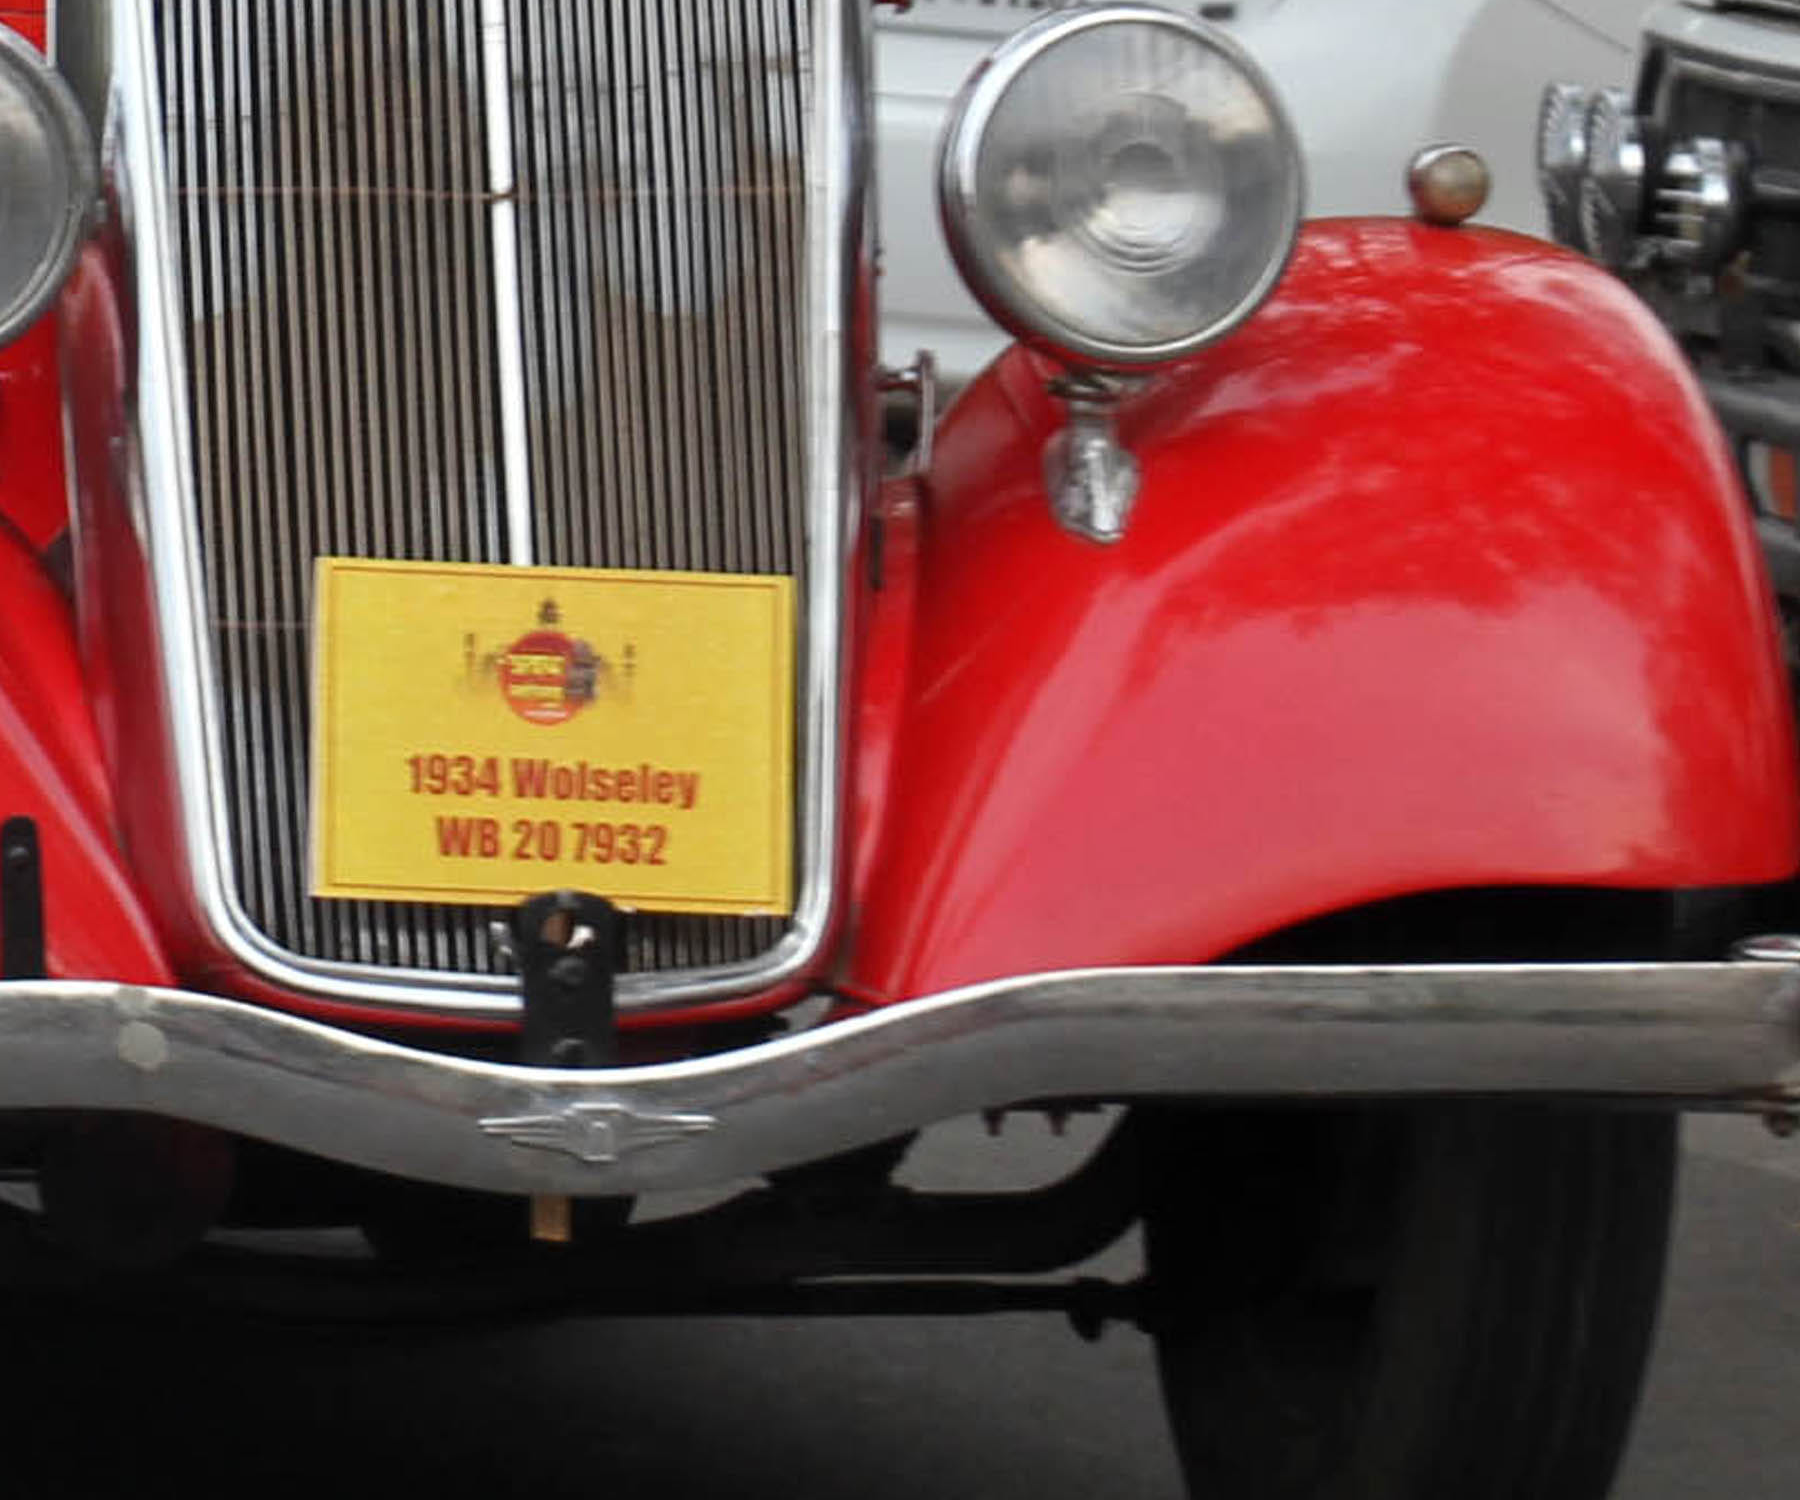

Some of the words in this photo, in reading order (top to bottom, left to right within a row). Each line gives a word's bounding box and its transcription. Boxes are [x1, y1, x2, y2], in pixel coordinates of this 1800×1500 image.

[406, 754, 499, 796] 1934
[512, 758, 699, 809] Wolseley
[437, 816, 499, 858] WB
[512, 819, 561, 861] 20
[573, 822, 667, 865] 7932
